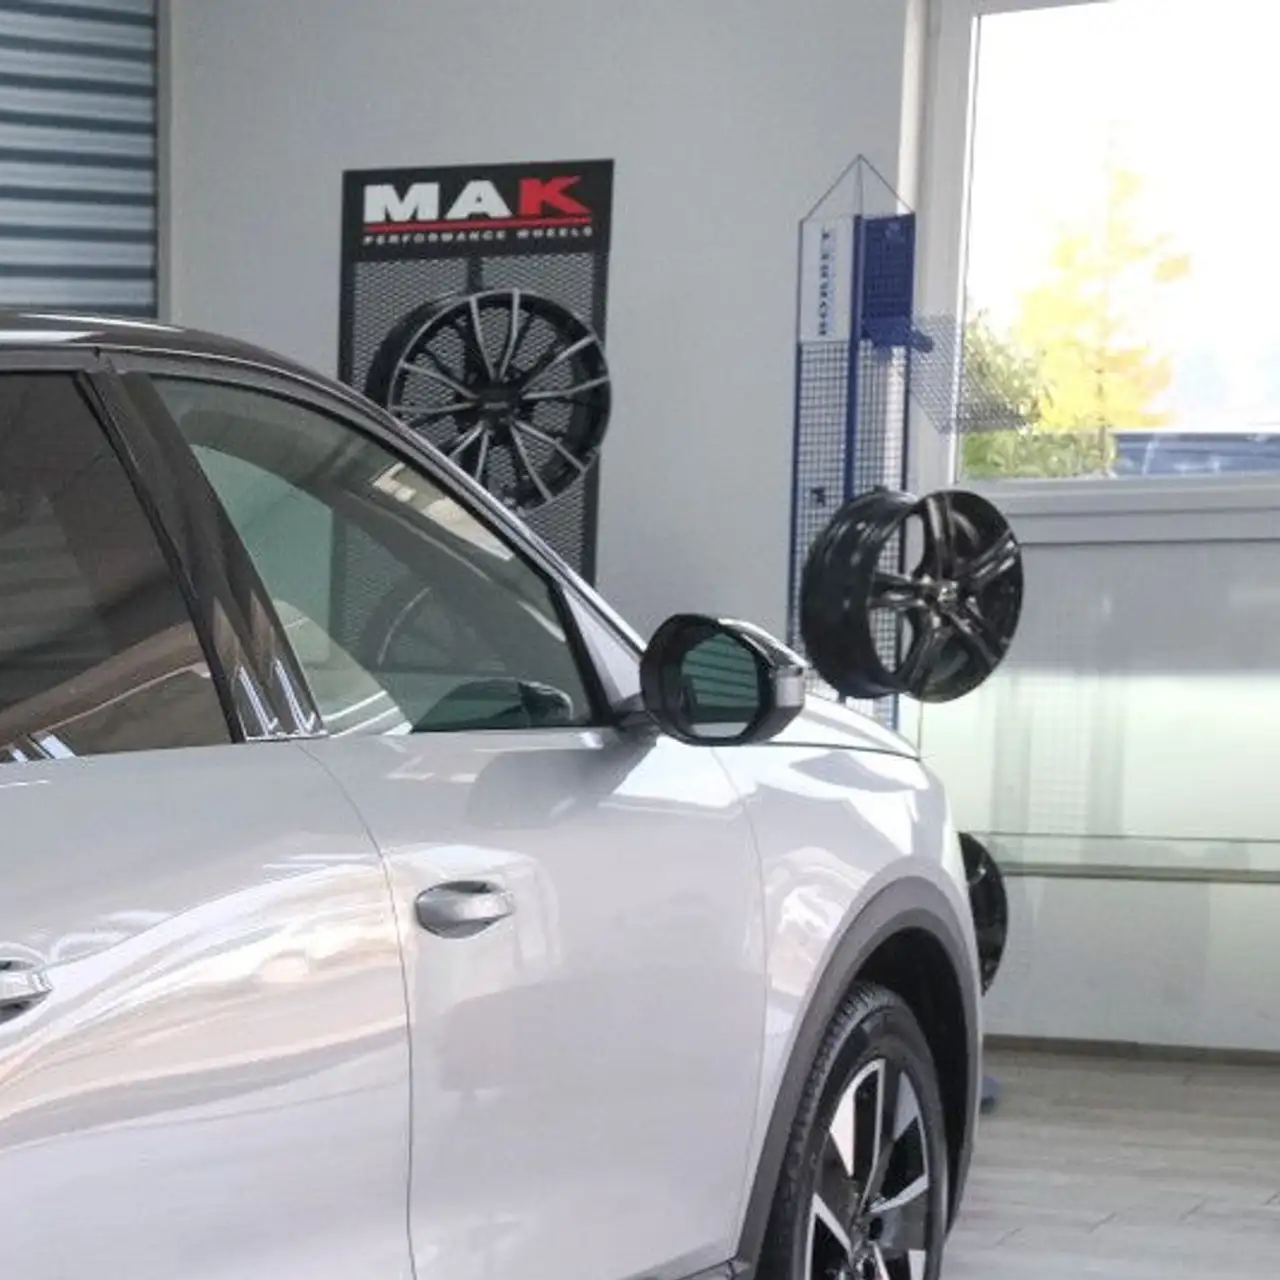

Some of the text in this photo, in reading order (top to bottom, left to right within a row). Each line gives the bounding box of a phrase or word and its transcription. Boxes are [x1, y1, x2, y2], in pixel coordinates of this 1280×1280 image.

[363, 175, 592, 223] MAK
[363, 226, 594, 245] PERFORMANCE WHEELS
